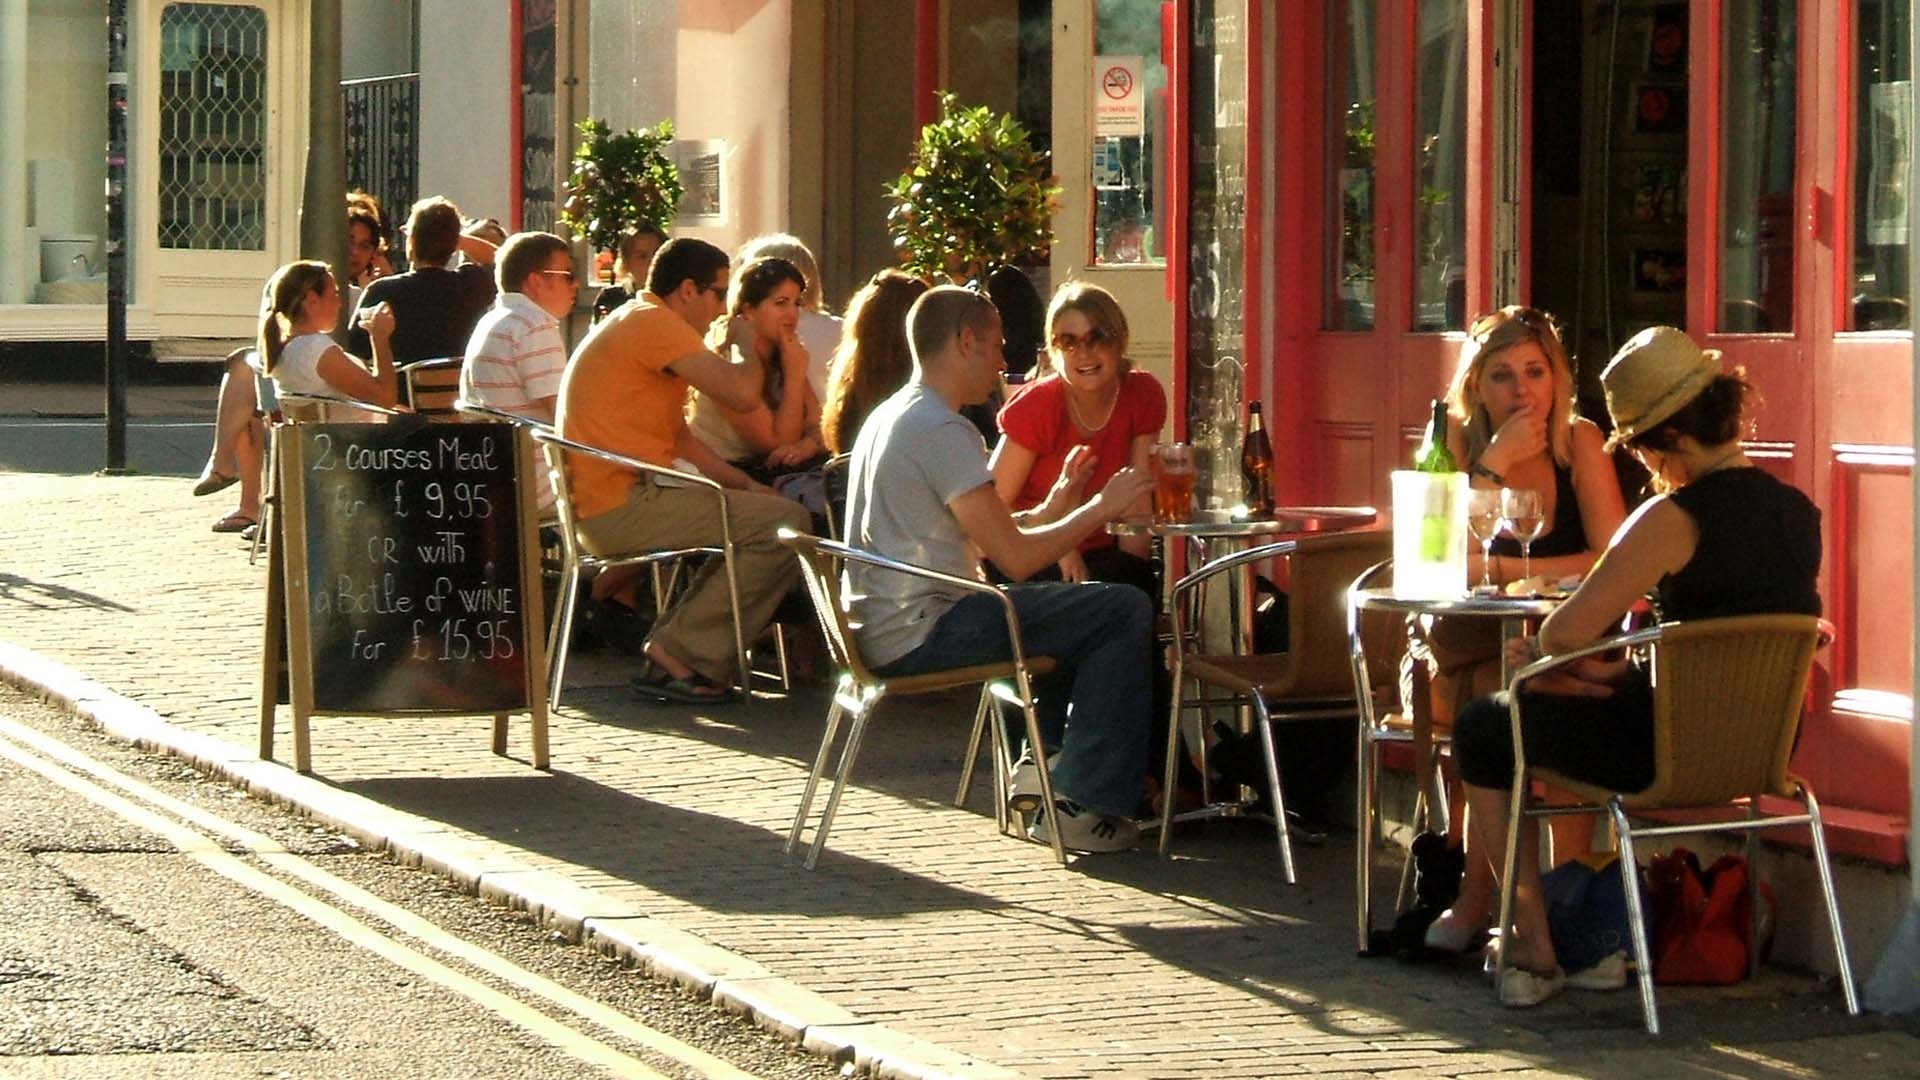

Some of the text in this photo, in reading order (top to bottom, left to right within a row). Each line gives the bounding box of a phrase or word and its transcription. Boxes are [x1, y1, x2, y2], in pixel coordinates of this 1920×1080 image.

[312, 433, 498, 471] 2 Courses Meal
[314, 590, 332, 614] a
[425, 576, 452, 613] of
[351, 629, 387, 660] For
